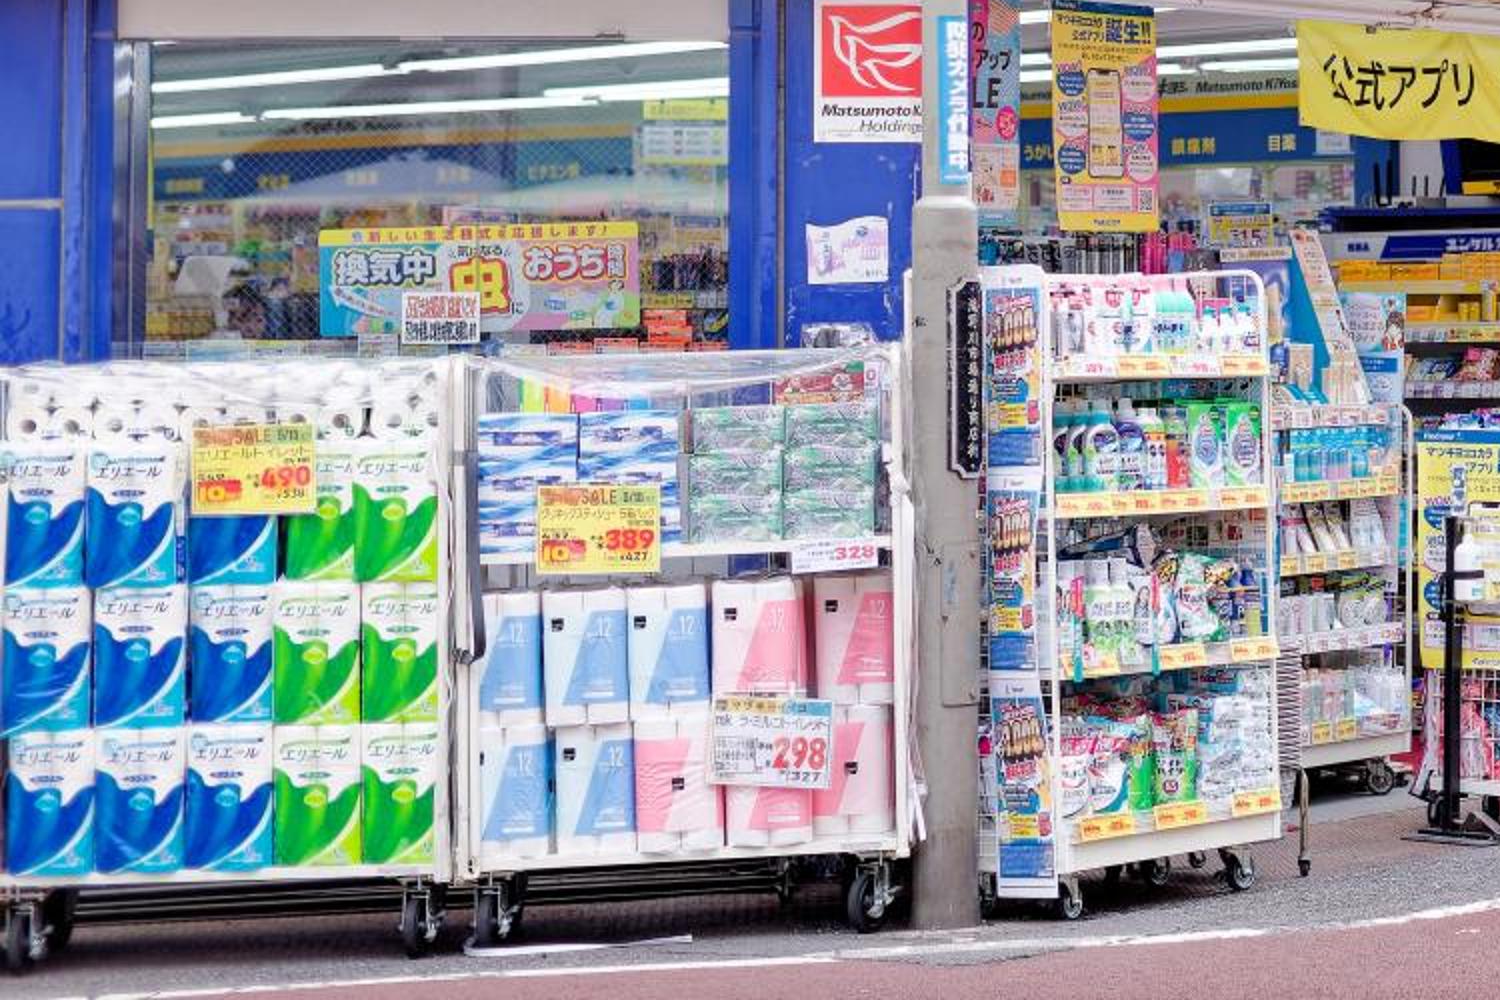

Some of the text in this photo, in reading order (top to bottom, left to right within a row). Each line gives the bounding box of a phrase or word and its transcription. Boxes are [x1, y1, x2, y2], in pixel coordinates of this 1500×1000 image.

[1196, 78, 1263, 93] Matsumoto
[1323, 54, 1474, 110] 公式アプリ
[335, 250, 435, 286] 換気中
[96, 463, 162, 479] エリエール
[262, 466, 311, 489] 490
[606, 529, 655, 551] 389
[834, 545, 875, 561] 328
[102, 600, 169, 617] エリエール
[201, 602, 264, 618] エリエール
[281, 602, 347, 618] エリエール
[16, 748, 80, 765] エリエール
[107, 747, 173, 764] エリエール
[197, 745, 260, 761] エリエール
[282, 747, 348, 764] エリエール
[369, 744, 435, 760] エリエール
[772, 735, 827, 770] 298
